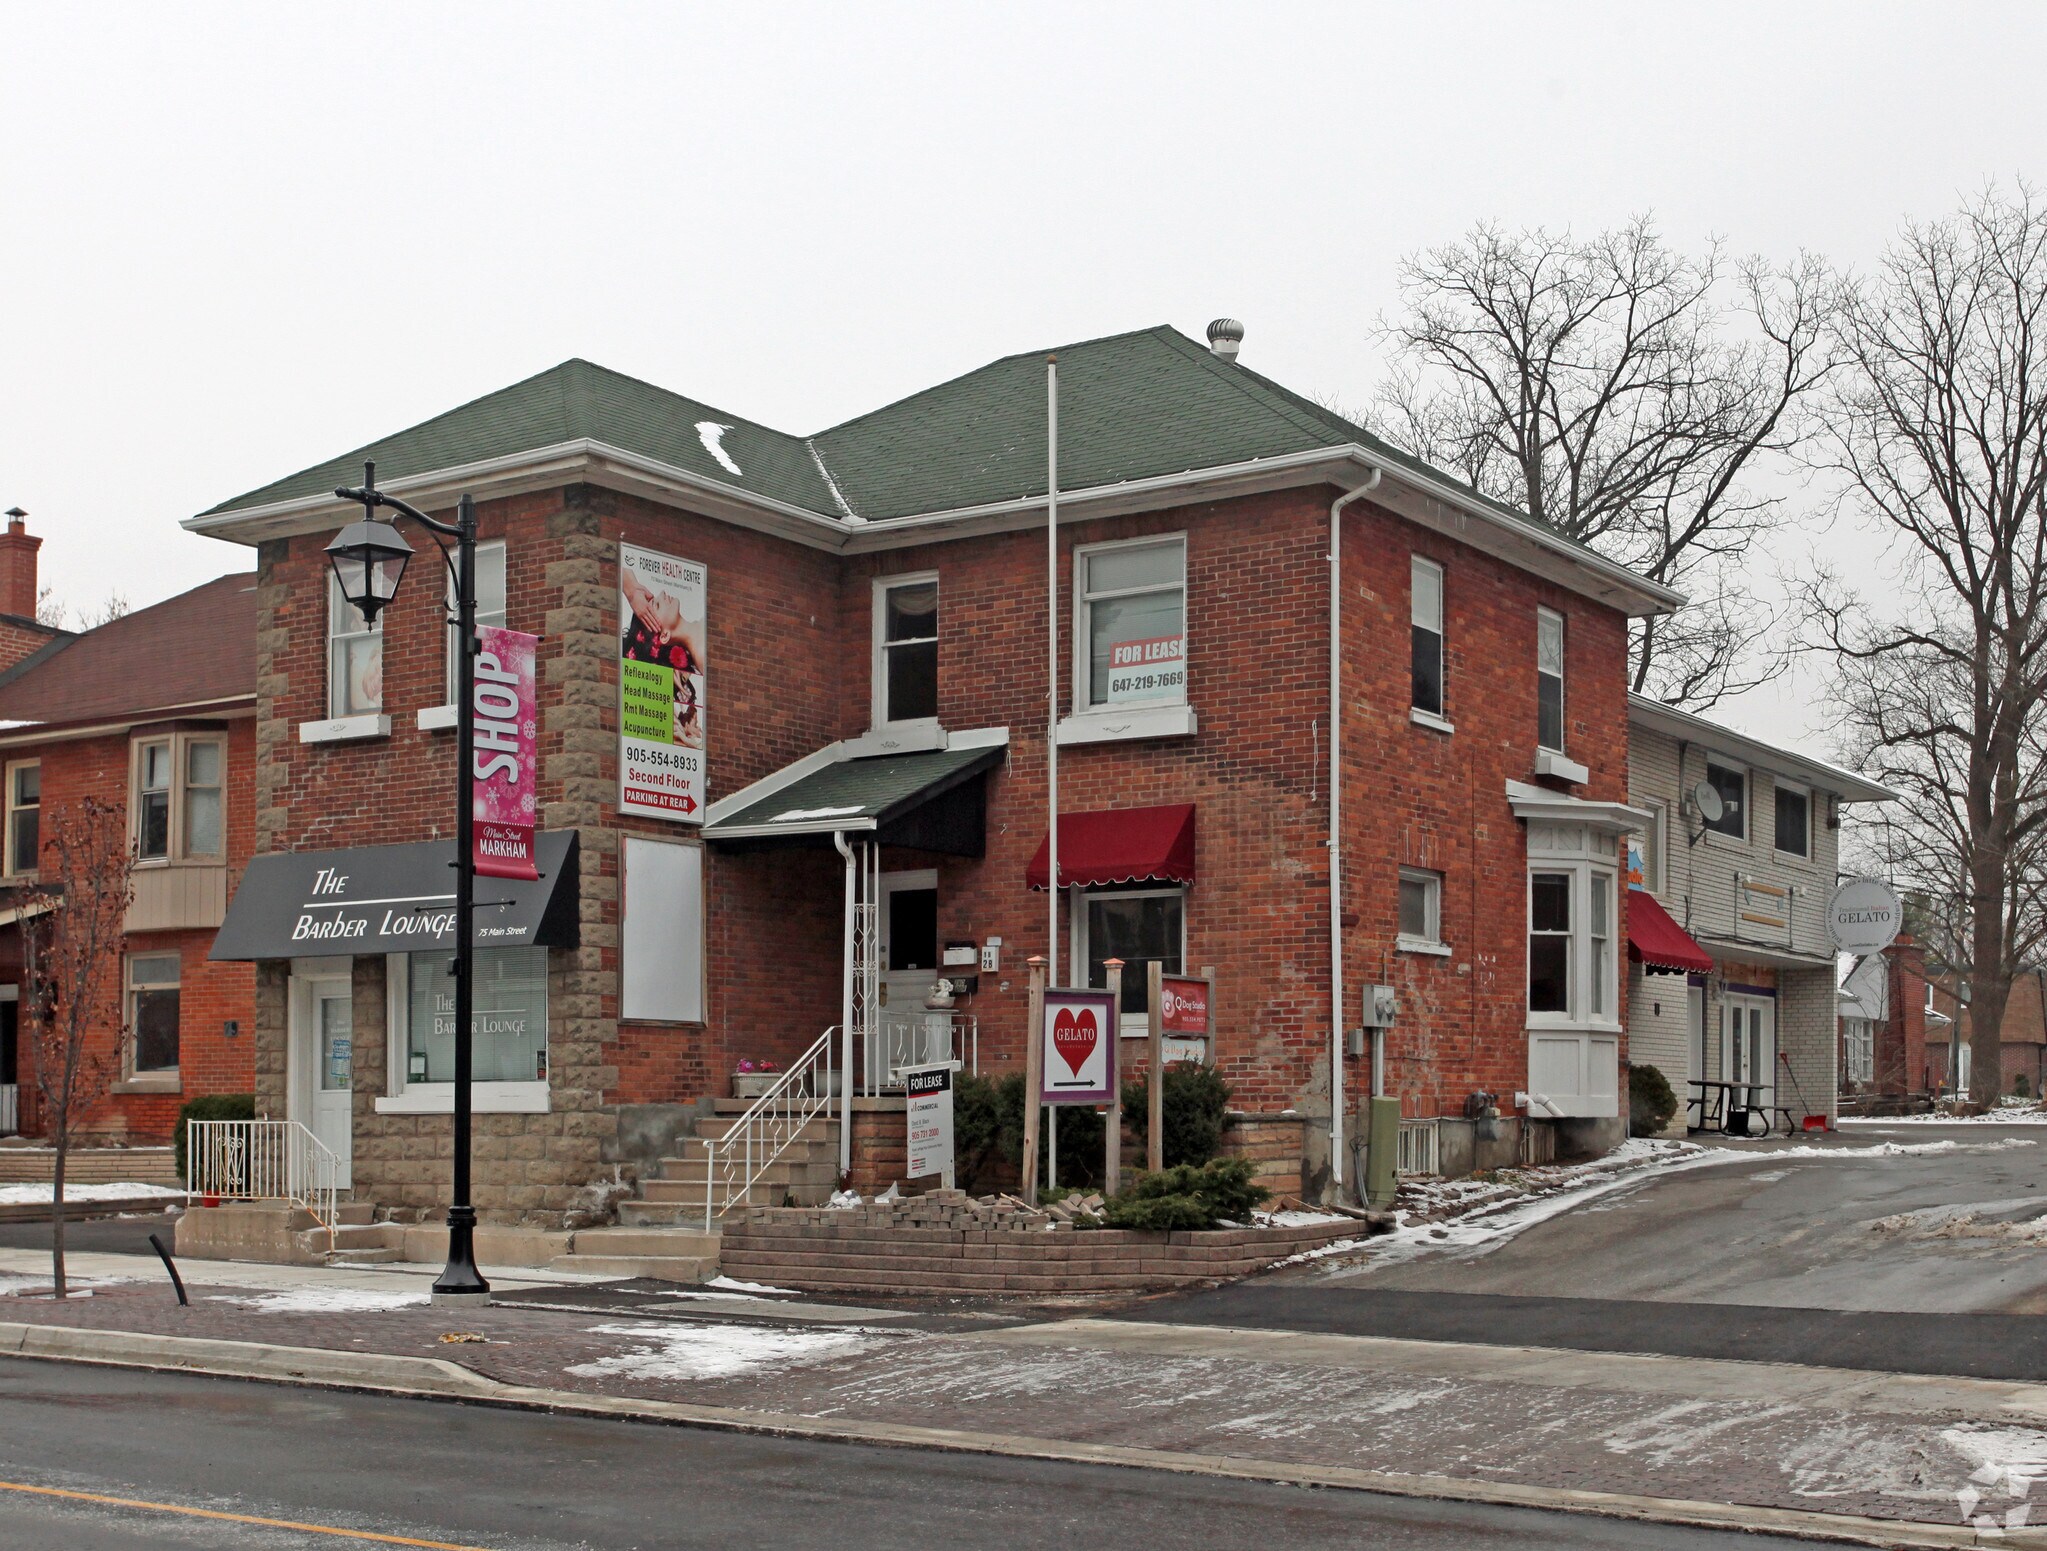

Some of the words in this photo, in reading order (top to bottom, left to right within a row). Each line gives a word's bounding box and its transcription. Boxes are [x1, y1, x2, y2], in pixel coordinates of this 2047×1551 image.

[639, 557, 661, 573] FOREVER
[662, 561, 682, 580] HEALTH
[683, 569, 701, 585] CENTRE
[1114, 645, 1142, 664] FOR
[624, 665, 663, 686] Reflexalogy
[1112, 671, 1183, 692] 647-219-7669
[624, 684, 641, 698] Head
[642, 687, 671, 705] Massage
[473, 651, 519, 784] SHOP
[624, 702, 638, 715] Rmt
[639, 705, 667, 722] Massage
[624, 720, 666, 738] Acupuncture
[626, 746, 698, 772] 905-554-8933
[629, 768, 664, 786] Second
[666, 774, 690, 790] Floor
[626, 790, 658, 805] PARKING
[659, 796, 668, 806] AT
[670, 798, 688, 809] REAR
[483, 826, 502, 839] Main
[502, 828, 522, 840] Street
[480, 838, 527, 858] MARKHAM
[1838, 911, 1890, 924] GELATO
[478, 928, 488, 936] 75
[488, 928, 504, 936] Main
[505, 926, 527, 936] Street
[1175, 996, 1182, 1011] Q
[1182, 1000, 1192, 1011] Dog
[1056, 1028, 1094, 1041] GELATO
[910, 1078, 924, 1090] FOR
[924, 1075, 942, 1088] LEASE
